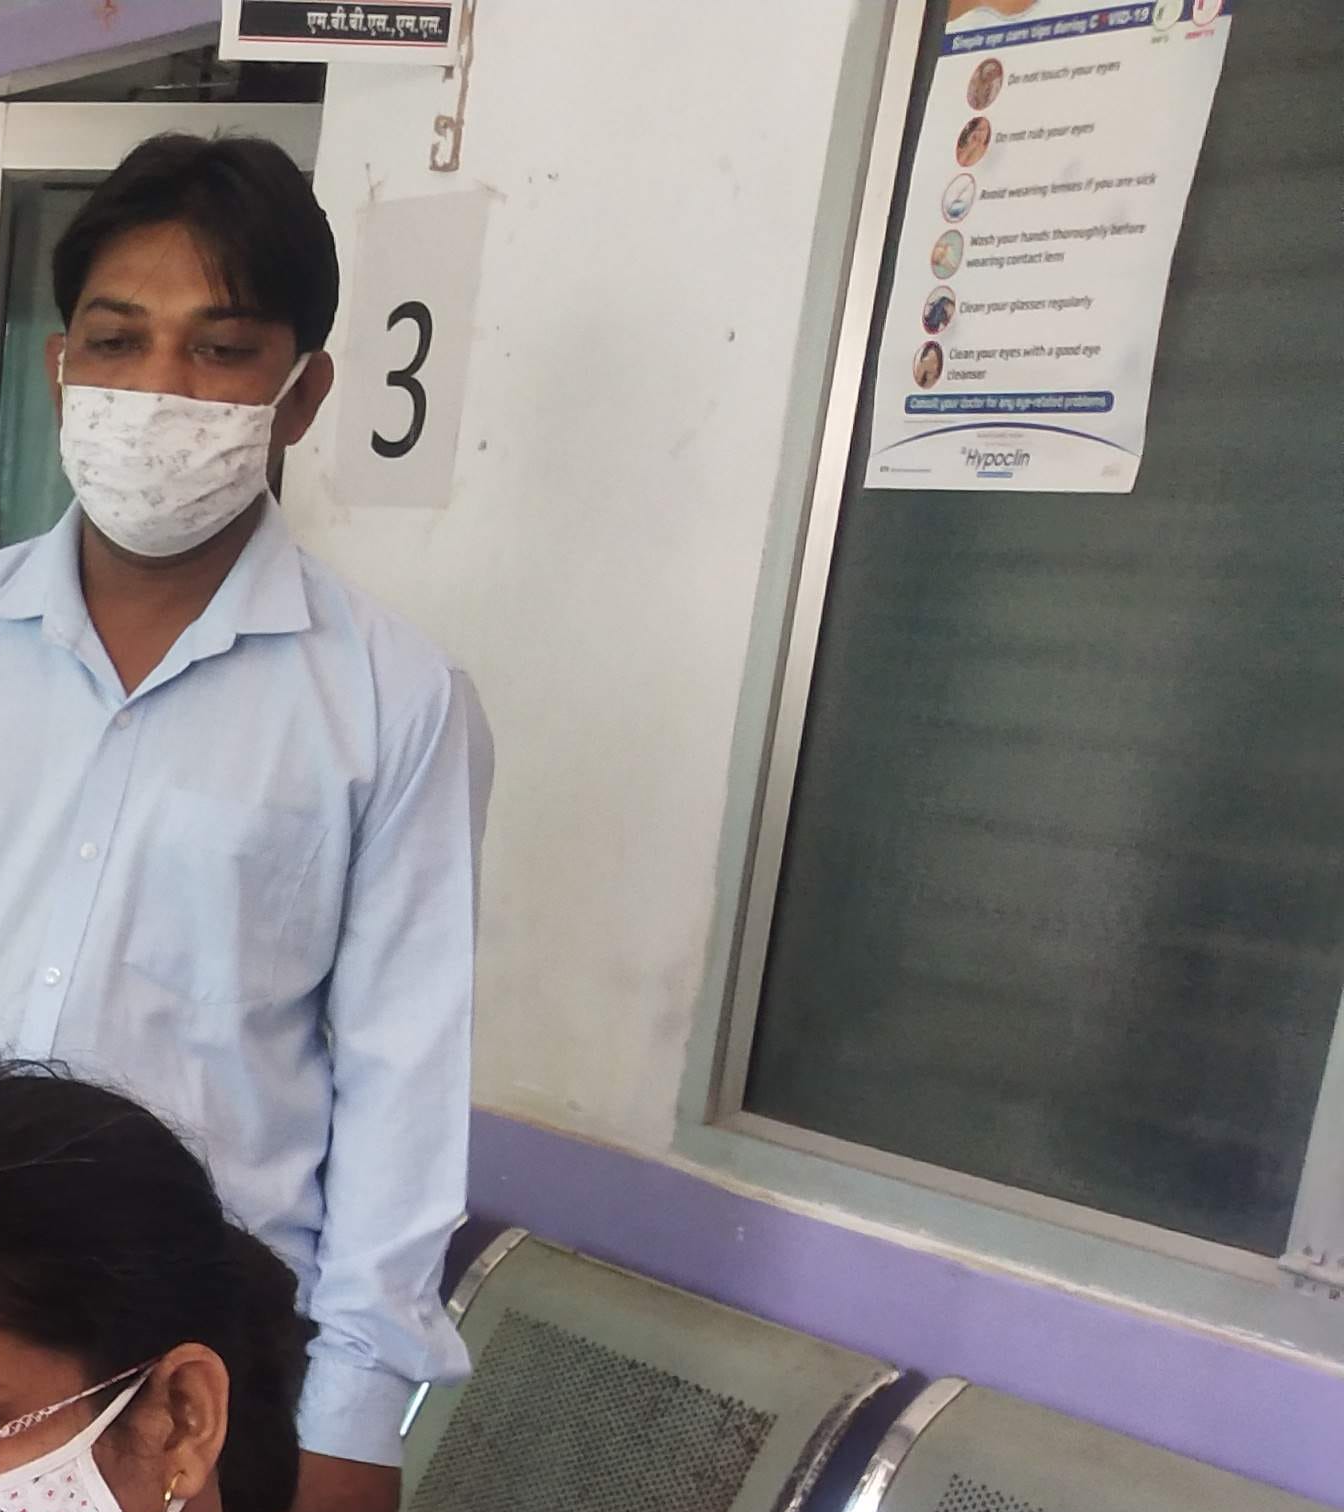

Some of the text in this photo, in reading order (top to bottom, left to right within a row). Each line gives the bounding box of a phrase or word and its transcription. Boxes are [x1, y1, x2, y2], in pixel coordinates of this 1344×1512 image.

[1070, 65, 1096, 79] your
[1045, 126, 1070, 141] your
[1071, 123, 1095, 136] eyes
[1093, 178, 1114, 192] you
[995, 235, 1019, 248] your
[985, 301, 1009, 314] your
[949, 348, 975, 361] Clean
[976, 348, 996, 361] your
[998, 347, 1021, 361] eyes
[1023, 344, 1046, 357] with
[1054, 343, 1081, 359] good
[1082, 345, 1101, 359] eye
[370, 300, 433, 459] 3
[966, 447, 1031, 470] Hypoclin
